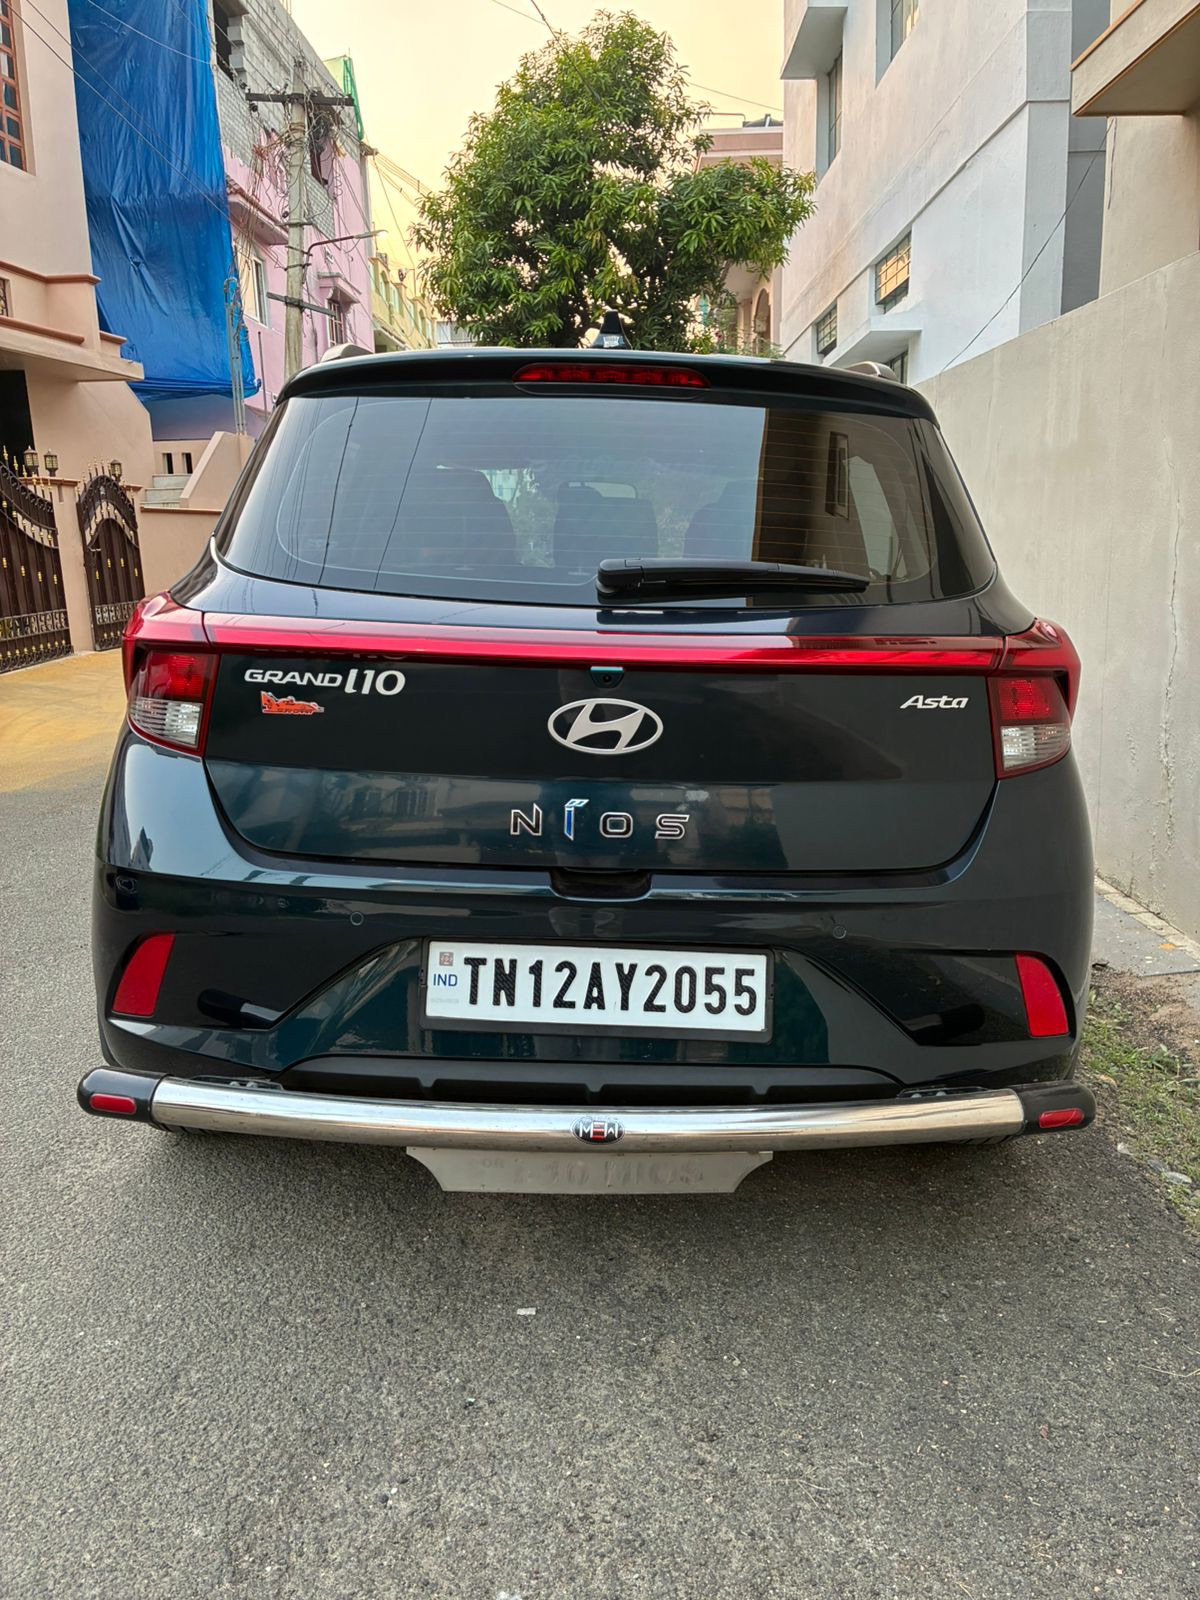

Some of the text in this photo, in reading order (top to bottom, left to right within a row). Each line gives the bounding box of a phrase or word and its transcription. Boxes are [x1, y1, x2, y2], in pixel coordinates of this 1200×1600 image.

[244, 669, 343, 687] GRAND
[899, 694, 969, 709] Asta
[432, 973, 458, 987] IND
[464, 956, 758, 1016] TN12AY2055
